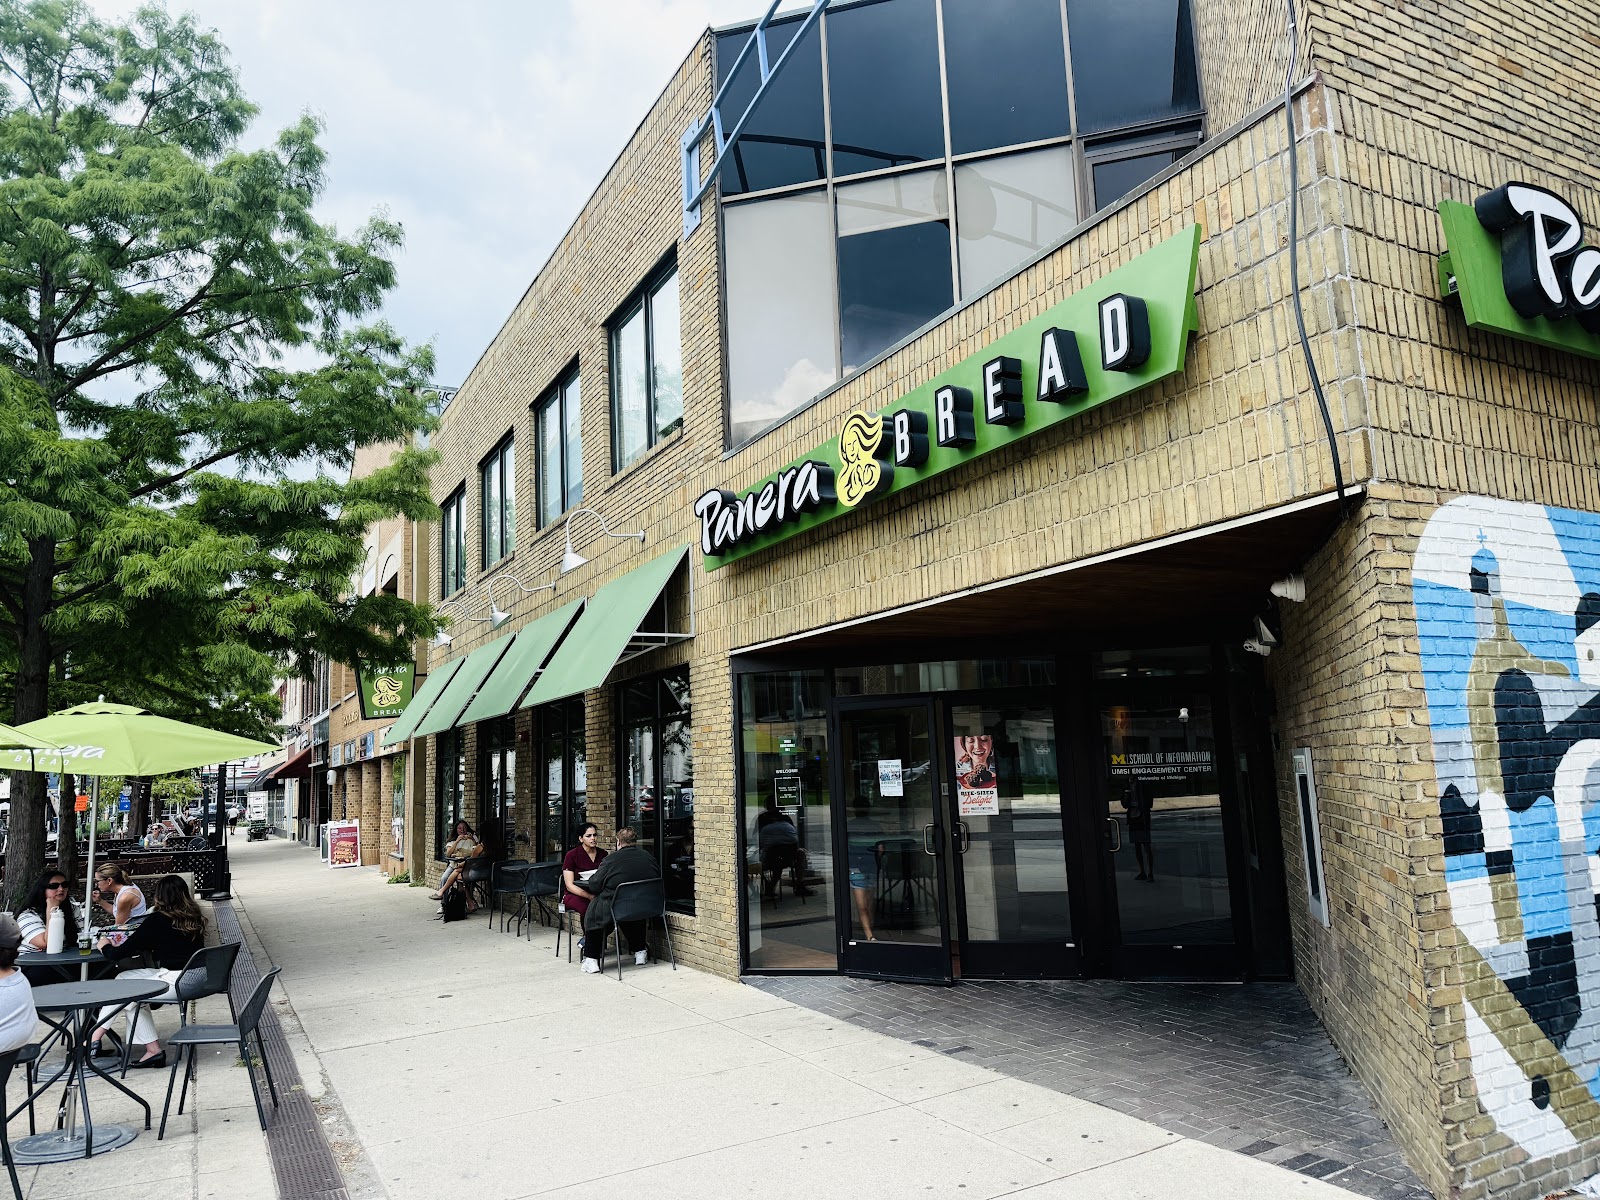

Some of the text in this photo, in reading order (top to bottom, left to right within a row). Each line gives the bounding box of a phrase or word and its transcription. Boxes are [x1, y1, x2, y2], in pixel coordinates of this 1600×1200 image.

[694, 293, 1136, 556] Panera BREAD
[373, 708, 404, 716] BREAD
[1110, 751, 1211, 765] M SCHOOL OF INFORMATION
[1132, 766, 1182, 775] ENGAGEMENT
[1183, 765, 1212, 773] CENTER
[962, 794, 993, 807] Delight
